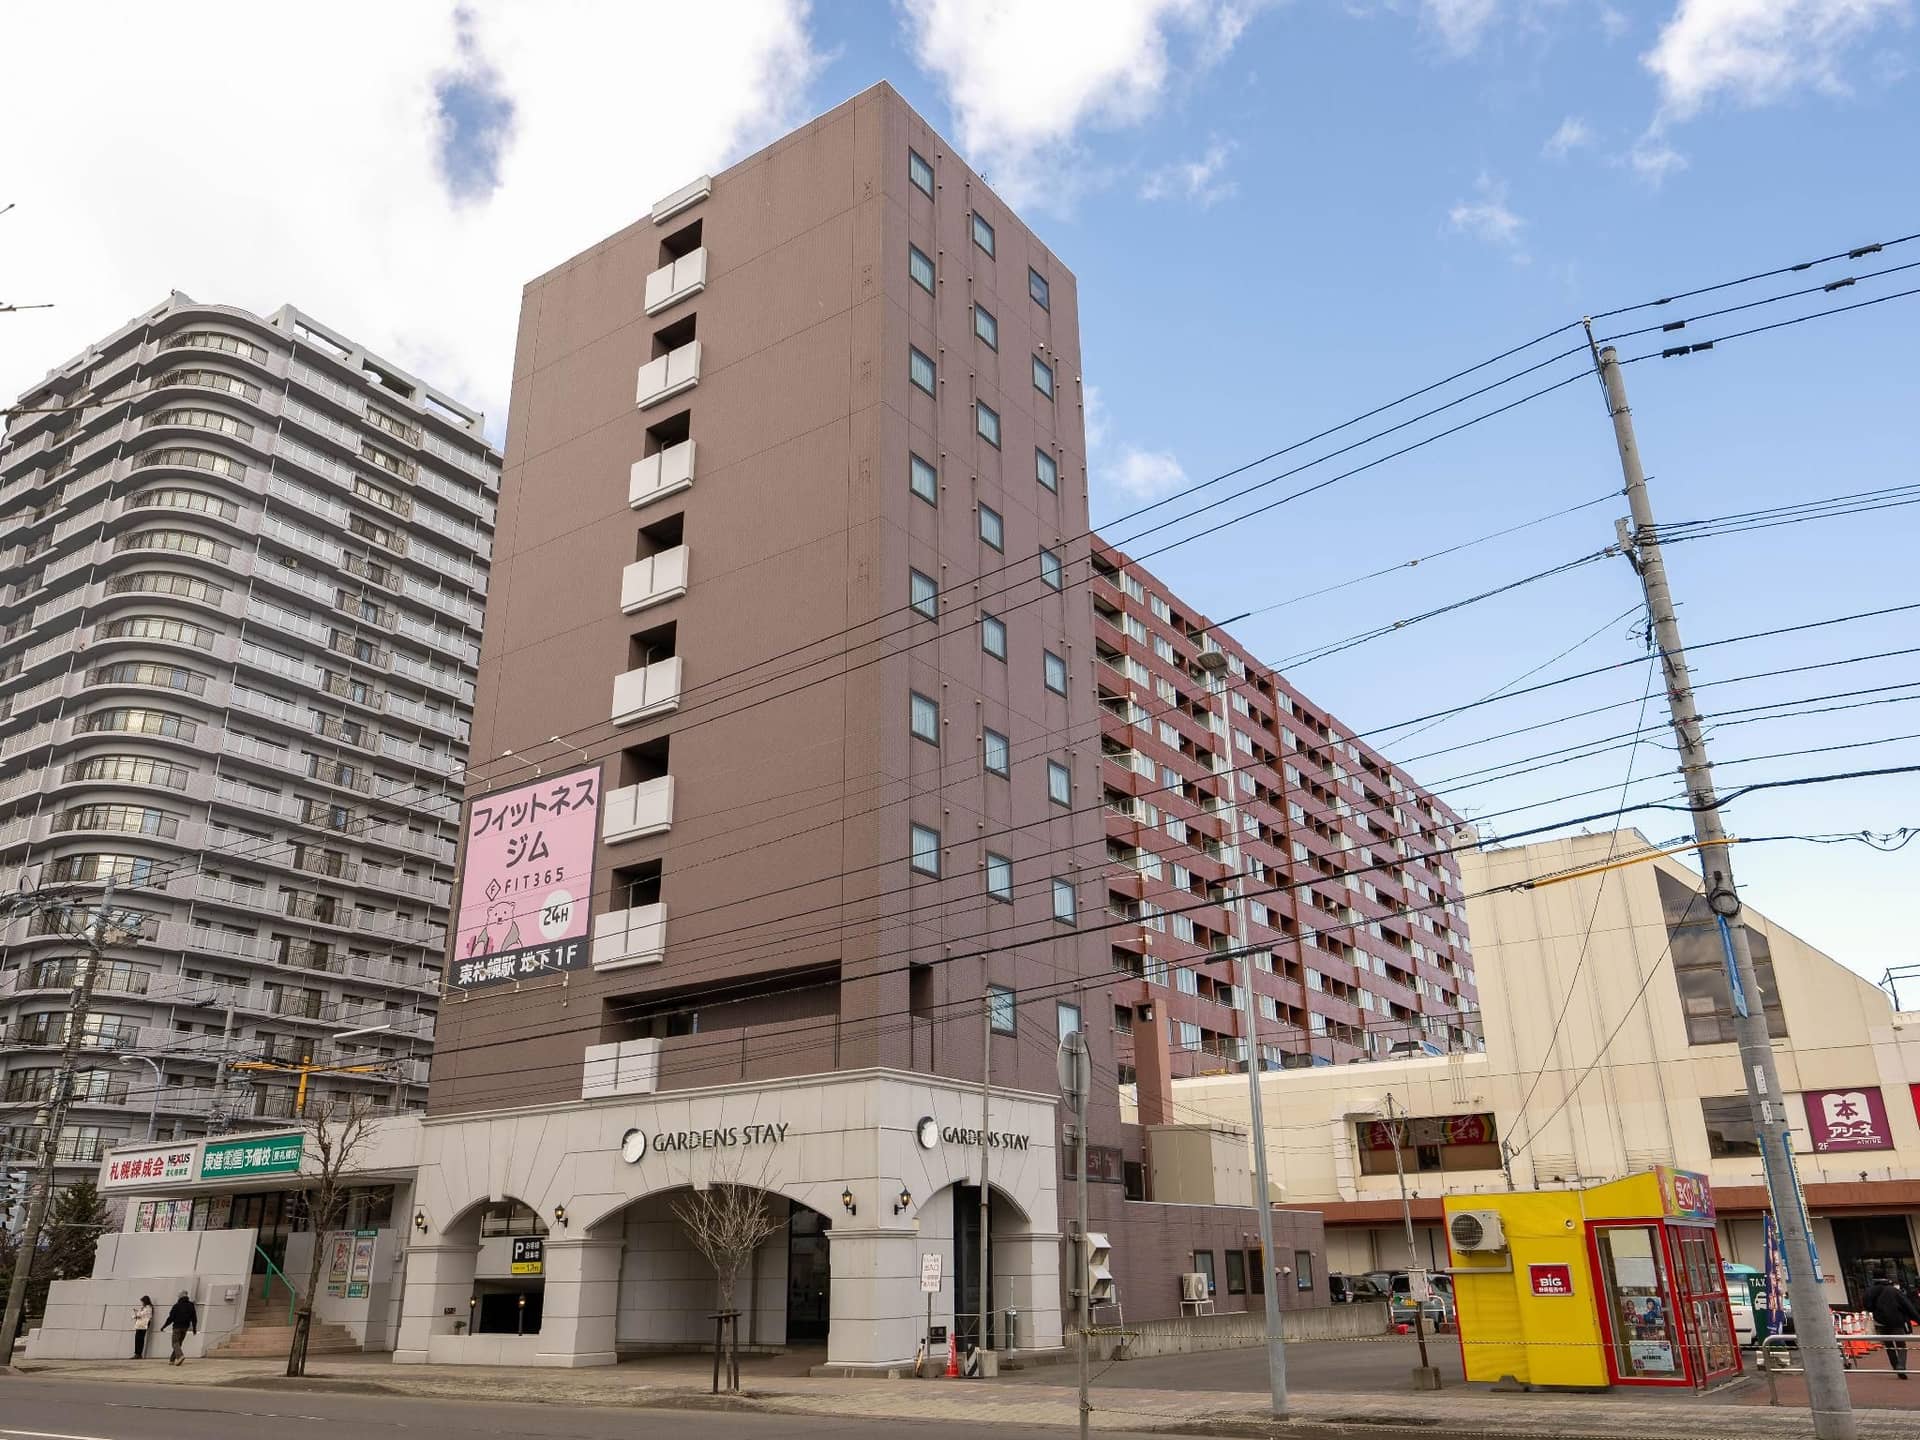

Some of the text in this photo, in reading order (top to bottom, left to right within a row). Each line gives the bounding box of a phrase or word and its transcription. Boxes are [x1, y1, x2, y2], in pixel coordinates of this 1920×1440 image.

[474, 779, 594, 836] フィットネス
[506, 831, 549, 868] ジム
[505, 867, 564, 894] FIT365
[544, 907, 569, 926] 24H
[1834, 1100, 1858, 1120] 本
[652, 1122, 789, 1152] GARDENS STAY
[942, 1126, 1029, 1151] GARDENS STAY
[1818, 1142, 1829, 1150] 2F
[110, 1156, 164, 1180] 札幌練成会
[167, 1153, 191, 1167] NEXUS
[515, 1242, 524, 1259] P
